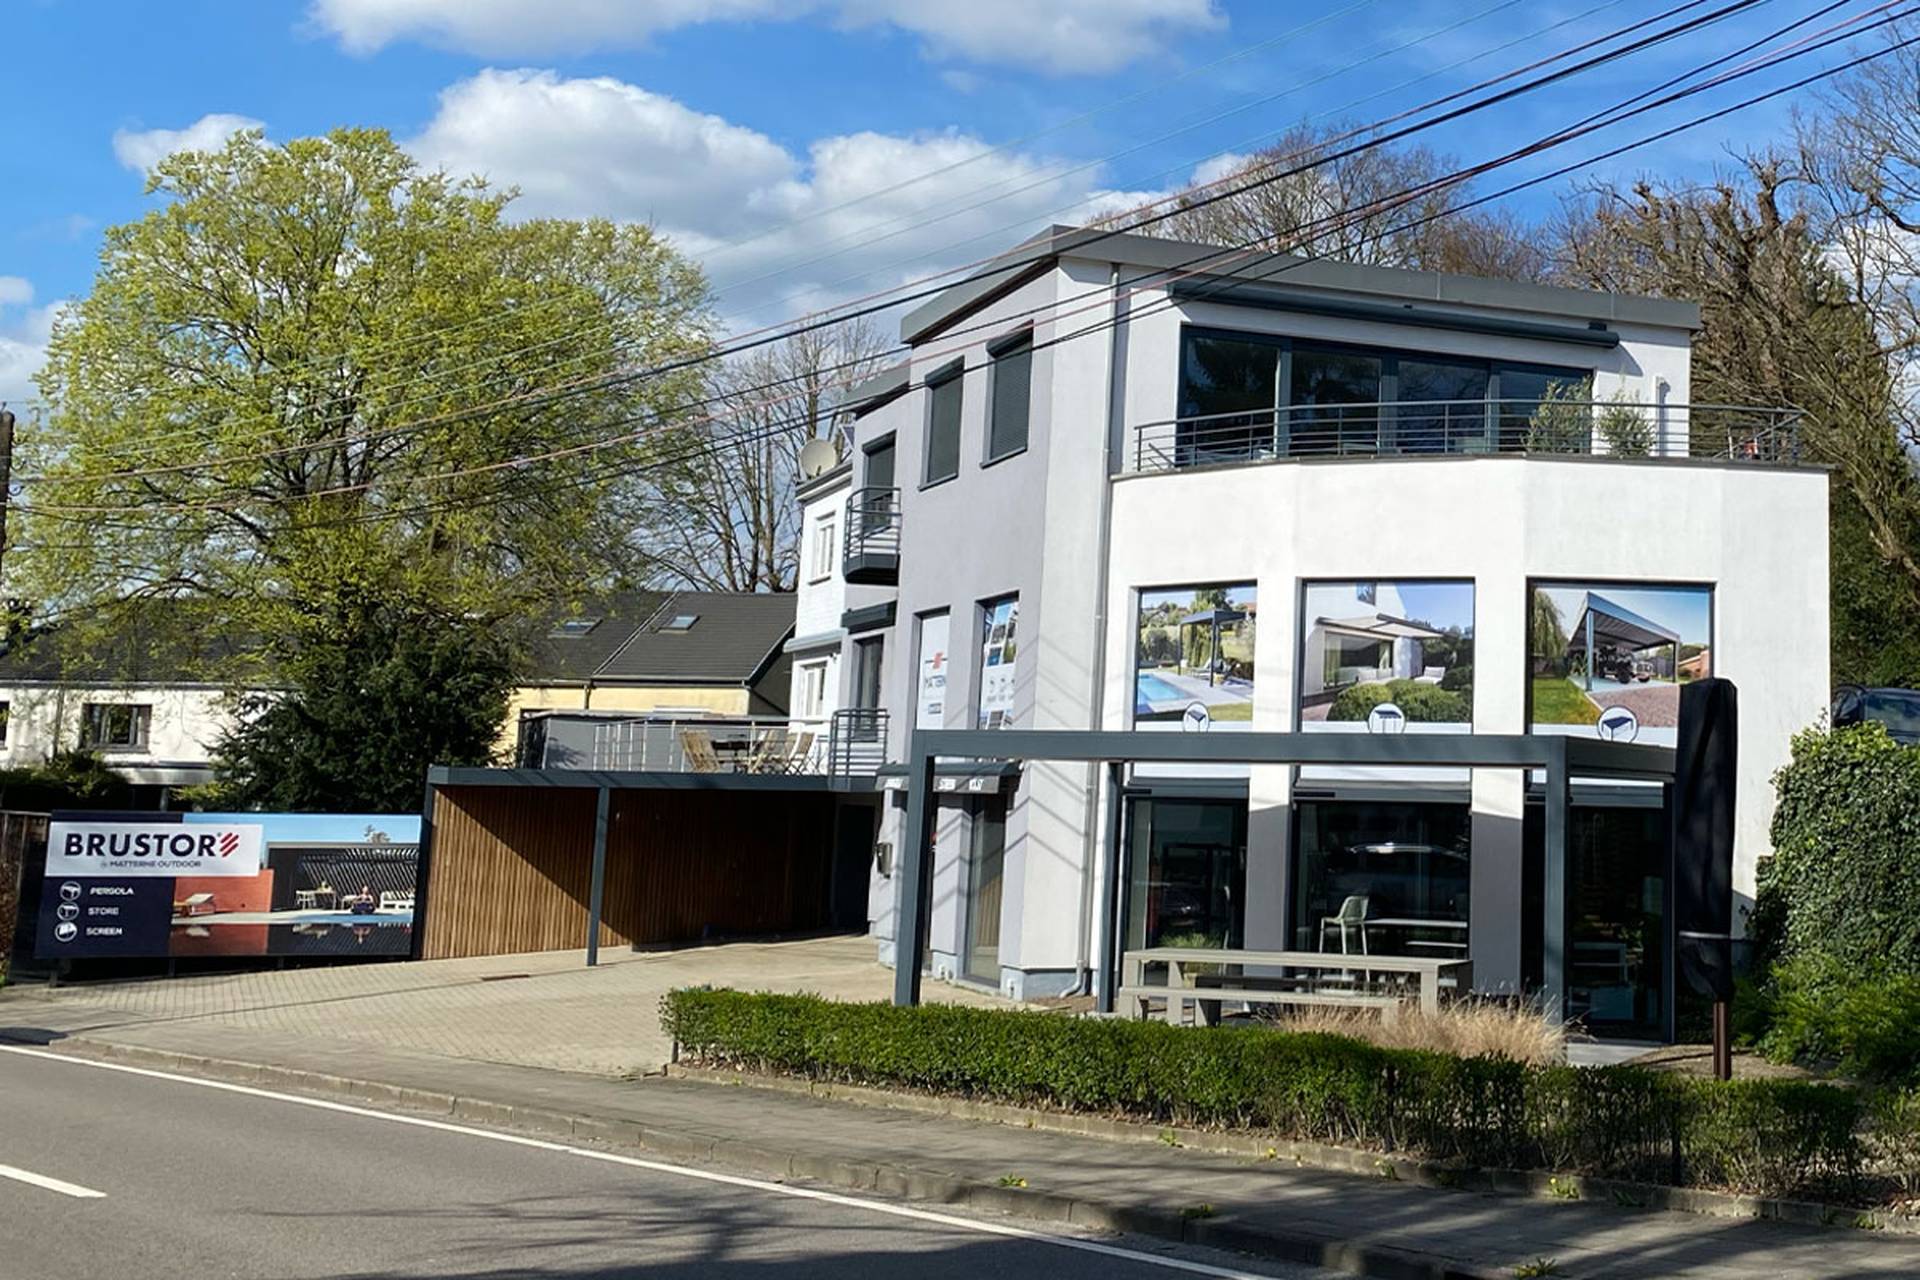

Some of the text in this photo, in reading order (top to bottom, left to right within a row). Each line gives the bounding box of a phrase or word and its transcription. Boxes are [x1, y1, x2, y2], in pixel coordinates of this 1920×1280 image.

[64, 832, 217, 857] BRUSTOR
[157, 860, 202, 868] OUTDOOR
[90, 887, 133, 895] PERGOLA
[88, 907, 119, 915] STORE
[86, 927, 122, 936] SCREEN
